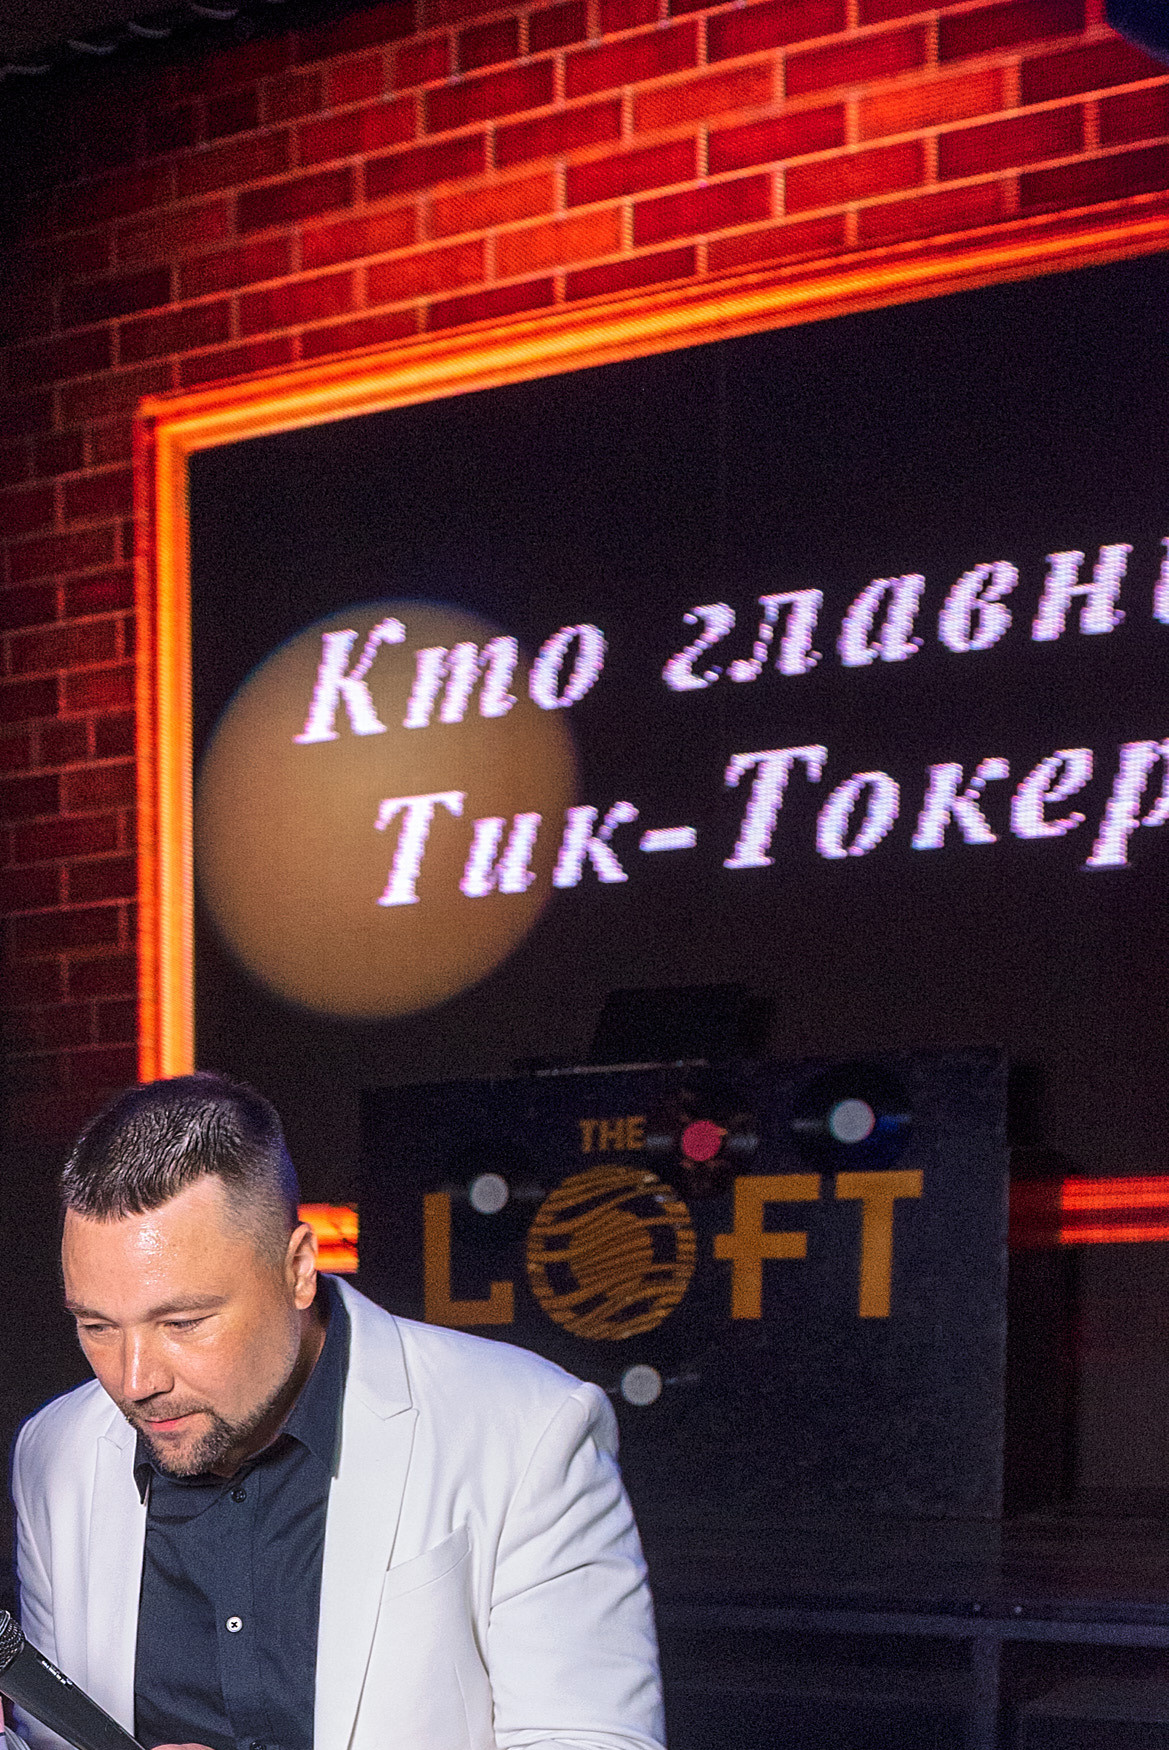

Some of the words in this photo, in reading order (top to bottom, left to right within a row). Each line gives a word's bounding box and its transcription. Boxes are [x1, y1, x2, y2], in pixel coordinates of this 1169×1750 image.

[292, 616, 607, 746] Кто
[663, 536, 1169, 692] главн
[579, 1116, 646, 1154] THE
[423, 1168, 924, 1341] LOFT
